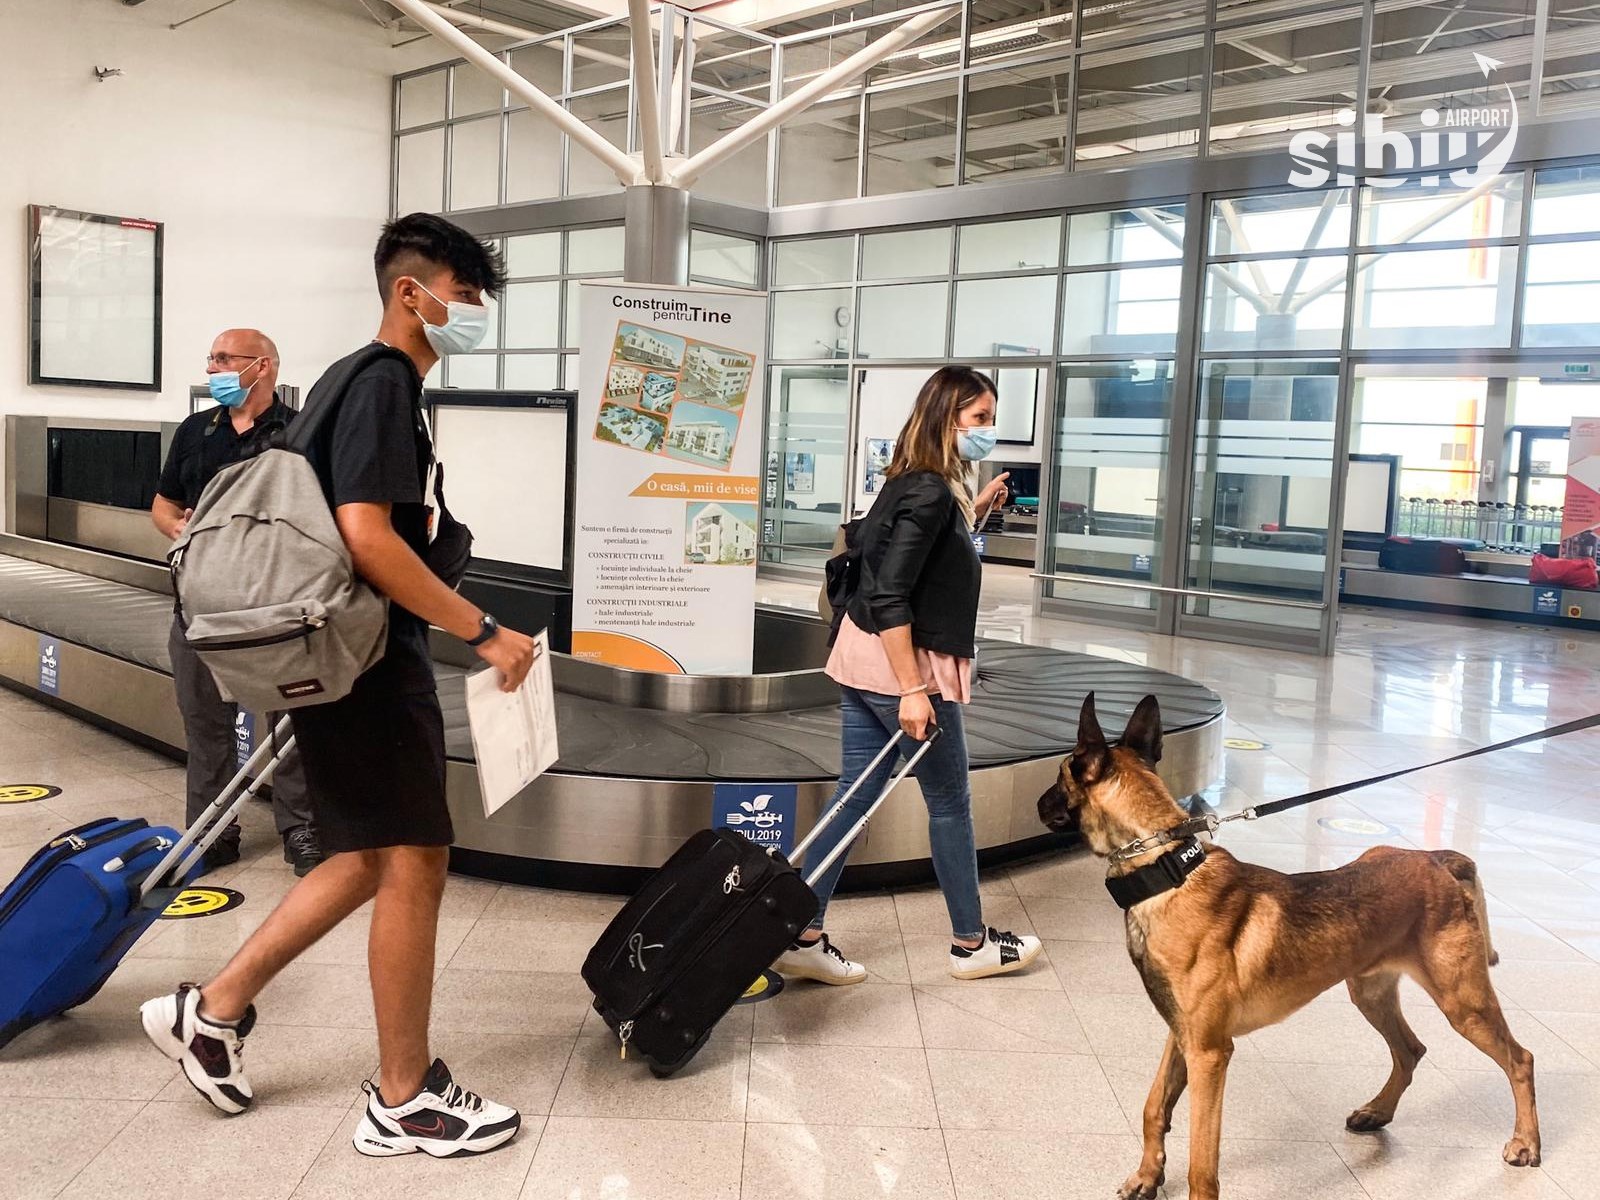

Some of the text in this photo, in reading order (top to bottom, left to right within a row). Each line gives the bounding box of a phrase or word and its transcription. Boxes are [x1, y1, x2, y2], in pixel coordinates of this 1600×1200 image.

[612, 295, 688, 312] Construim
[653, 306, 732, 323] pentru Tine
[646, 480, 757, 495] O casă, mii de vise
[581, 525, 606, 533] Suntem
[612, 526, 629, 534] firmă
[630, 526, 638, 534] de
[639, 553, 665, 561] CIVILE
[629, 565, 667, 573] individuale
[668, 565, 675, 573] la
[676, 566, 693, 574] cheie
[629, 574, 658, 582] colective
[667, 575, 684, 583] cheie
[635, 584, 668, 592] interioare
[638, 599, 688, 607] INDUSTRIALE
[658, 619, 695, 627] industriale
[757, 829, 782, 840] 2019
[1180, 841, 1202, 863] POLI
